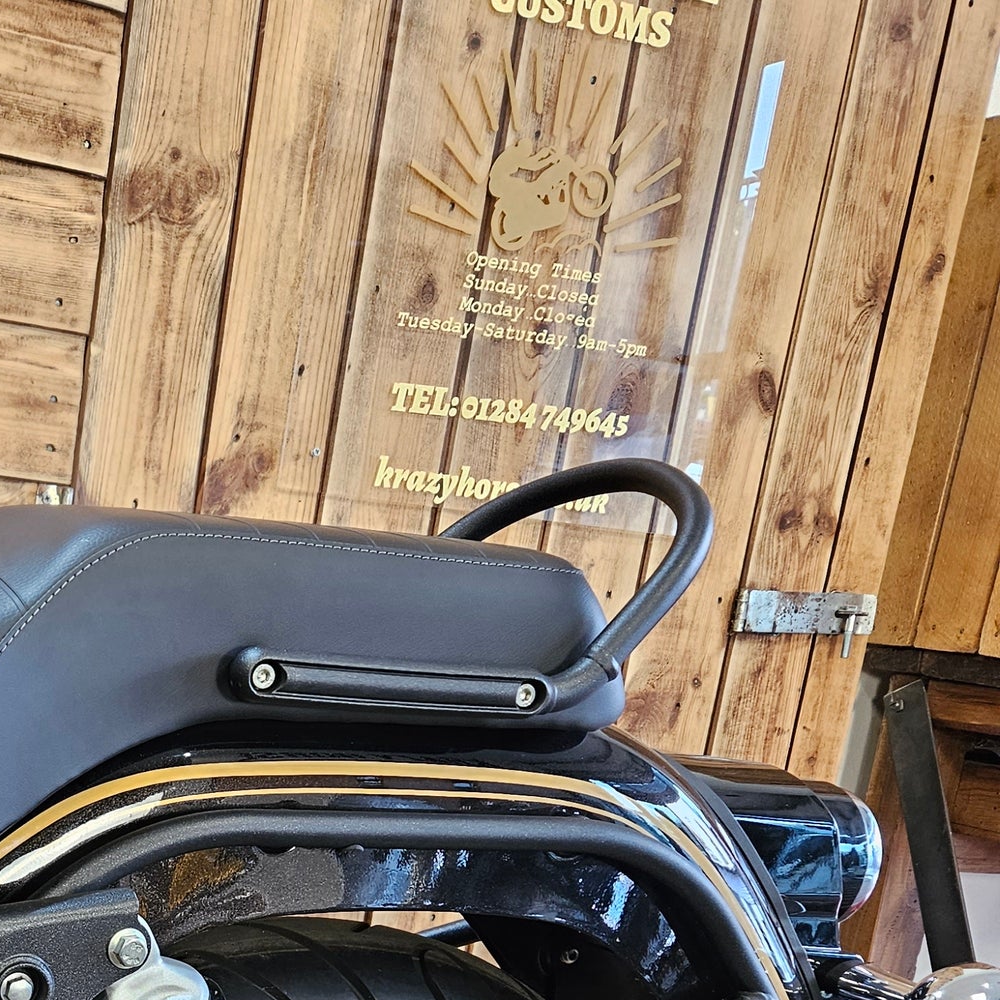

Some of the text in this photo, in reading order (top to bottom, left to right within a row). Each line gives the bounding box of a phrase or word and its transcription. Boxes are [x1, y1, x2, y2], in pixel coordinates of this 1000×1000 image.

[466, 251, 602, 284] Opening Times
[540, 405, 630, 438] 749645
